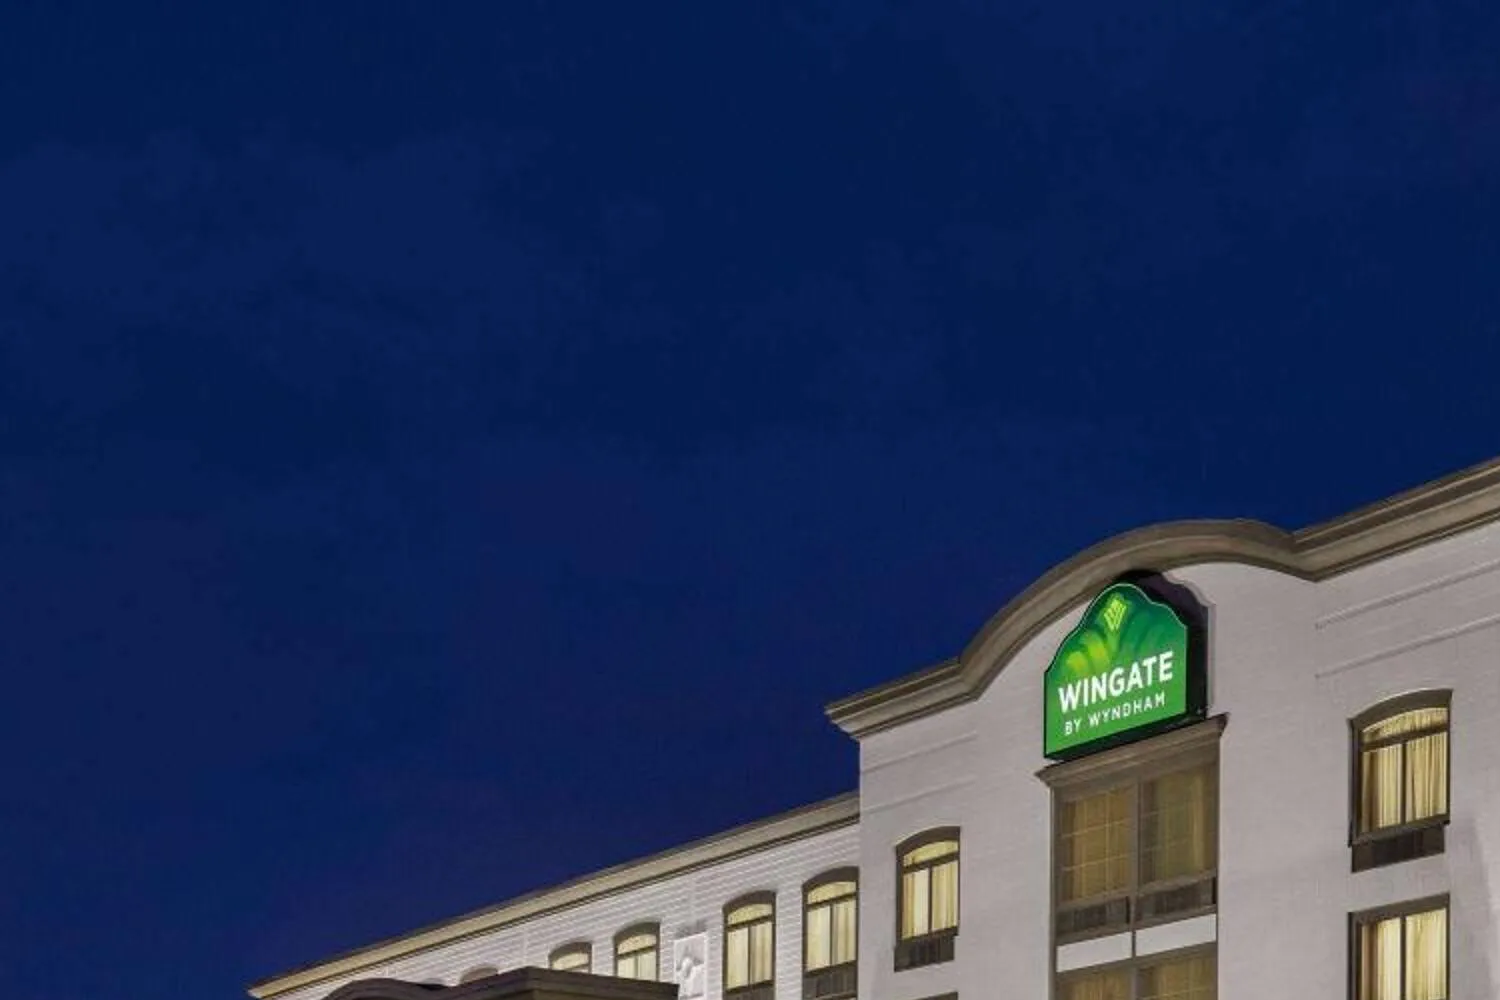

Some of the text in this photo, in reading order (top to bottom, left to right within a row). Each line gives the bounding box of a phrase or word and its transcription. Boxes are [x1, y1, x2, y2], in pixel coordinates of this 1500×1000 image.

[1058, 651, 1174, 713] WINGATE
[1064, 691, 1166, 736] BY WYNDHAM
